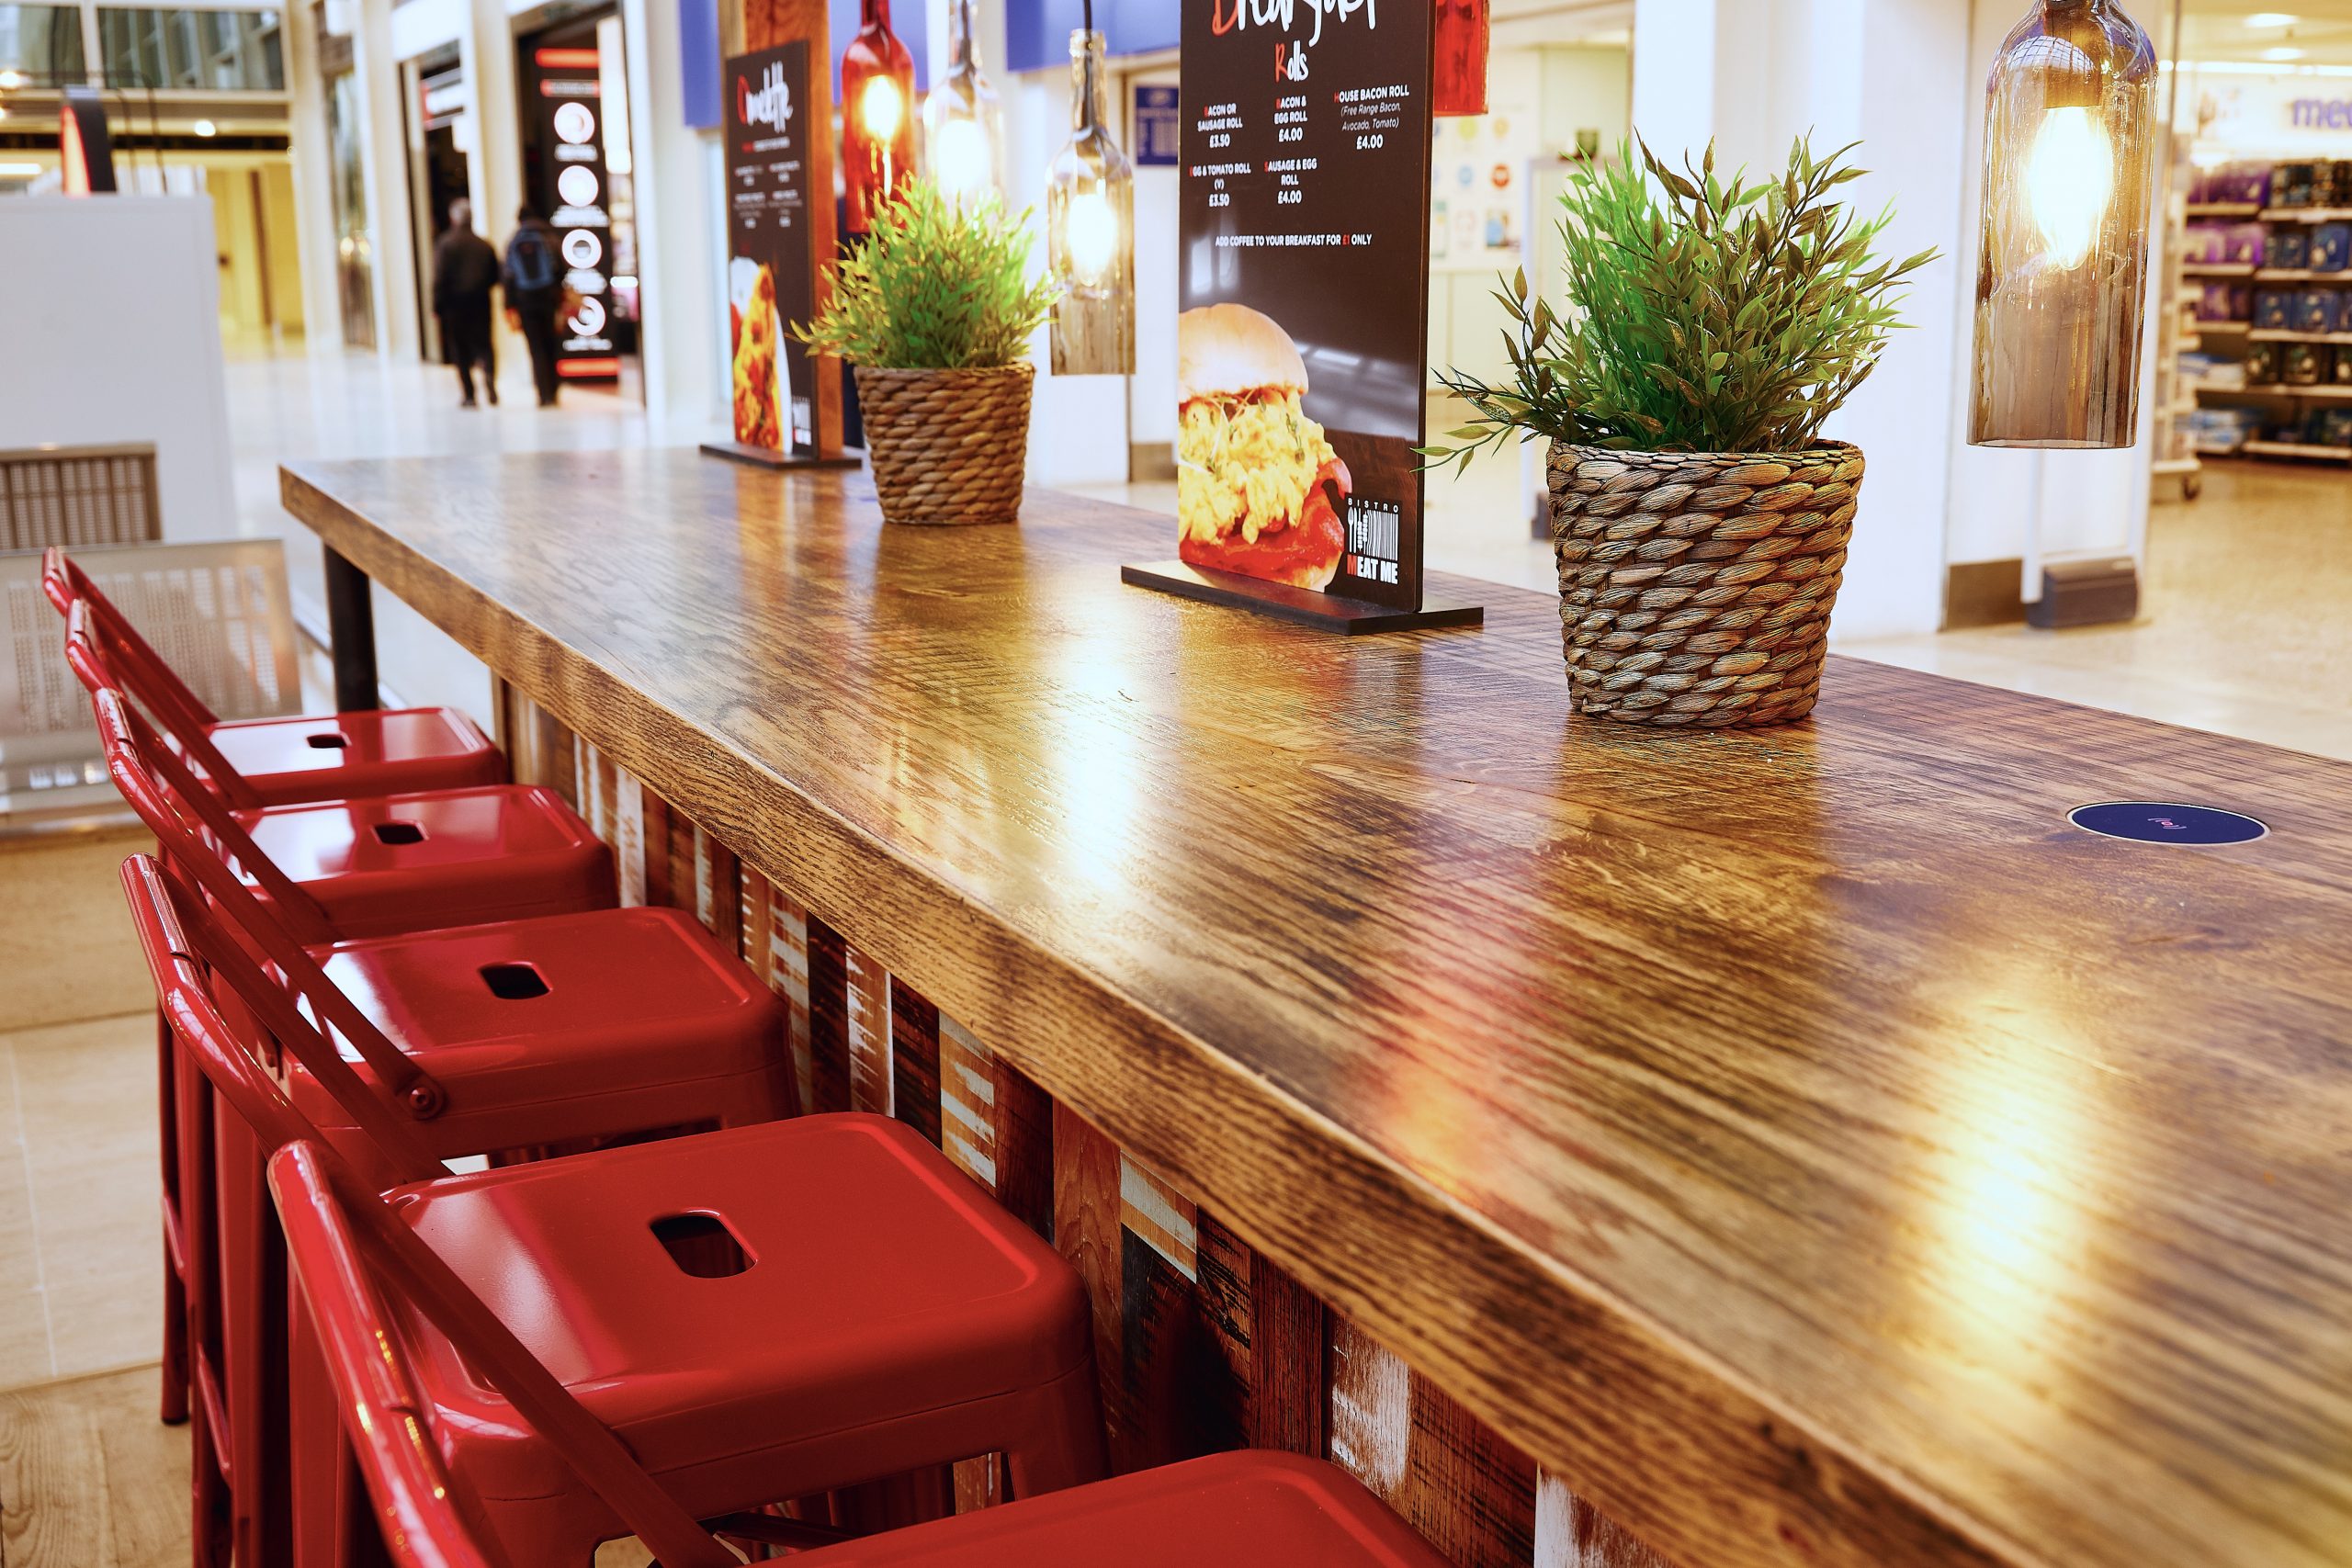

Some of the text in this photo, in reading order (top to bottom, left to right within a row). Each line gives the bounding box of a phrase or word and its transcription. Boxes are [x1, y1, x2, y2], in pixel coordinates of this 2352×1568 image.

[1275, 40, 1308, 83] Rolls
[1333, 85, 1409, 103] HOUSE BACON ROLL
[1275, 96, 1306, 109] BACON &
[1340, 102, 1401, 117] (Free Range Bacon,
[1204, 103, 1237, 117] BACON OR
[1273, 110, 1307, 124] EGG ROLL
[1197, 117, 1243, 132] SAUSAGE ROLL
[1341, 117, 1399, 131] Avocado, Tomato)
[1209, 133, 1230, 148] £3.50
[1278, 127, 1303, 142] £4.00
[1356, 134, 1384, 150] £4.00
[1189, 165, 1203, 177] EGG
[1208, 164, 1234, 175] TOMATO
[1234, 163, 1251, 174] ROLL
[1263, 158, 1317, 173] SAUSAGE & EGG
[1214, 178, 1225, 190] (V)
[1281, 175, 1299, 186] ROLL
[1208, 193, 1230, 207] £3.50
[1277, 190, 1303, 204] £4.00
[1216, 233, 1373, 247] ADD COFFEE TO YOUR BREAKFAST FOR £1 ONLY
[1348, 498, 1398, 513] BISTRO
[1347, 554, 1398, 585] MEAT ME
